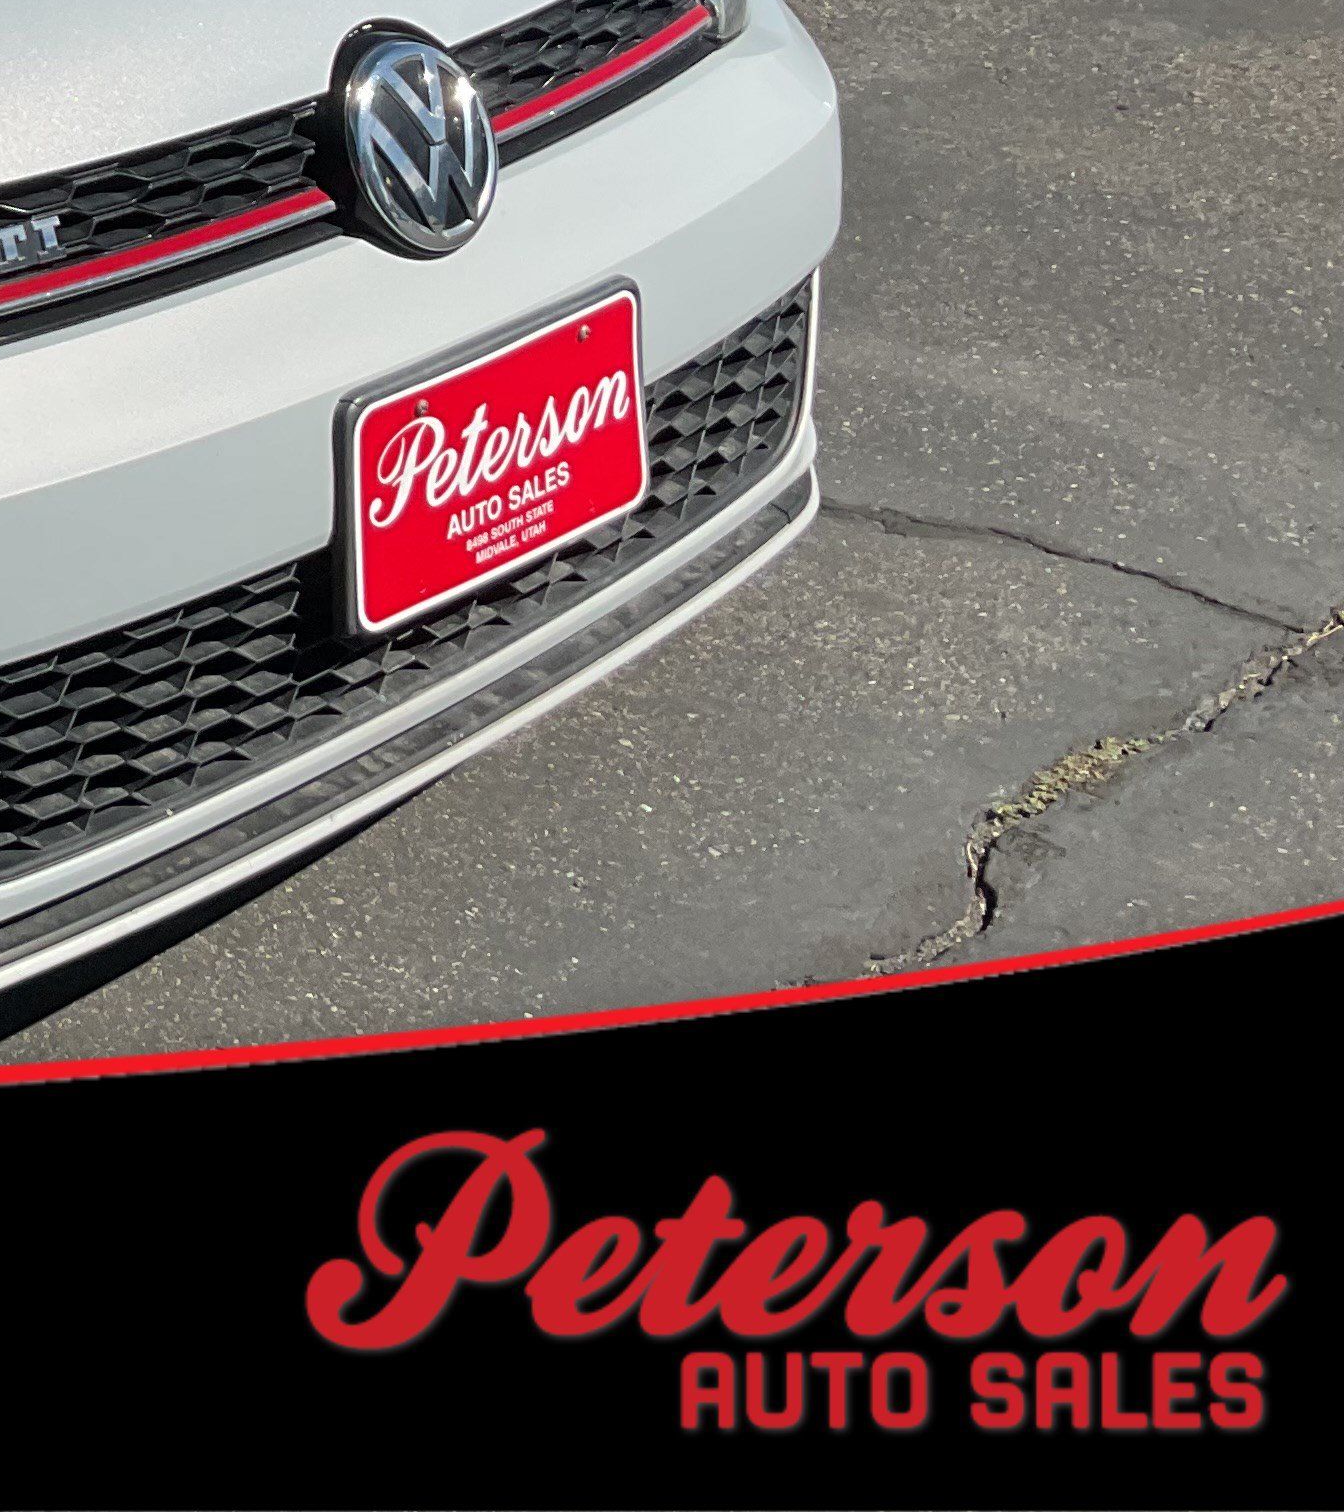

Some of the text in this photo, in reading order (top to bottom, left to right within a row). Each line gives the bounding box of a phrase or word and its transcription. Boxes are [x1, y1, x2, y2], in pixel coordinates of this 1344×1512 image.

[369, 369, 631, 529] Peterson
[447, 461, 570, 540] AUTO SALES
[491, 514, 524, 540] SOUTH
[525, 499, 554, 523] STATE
[521, 520, 546, 542] UTAH
